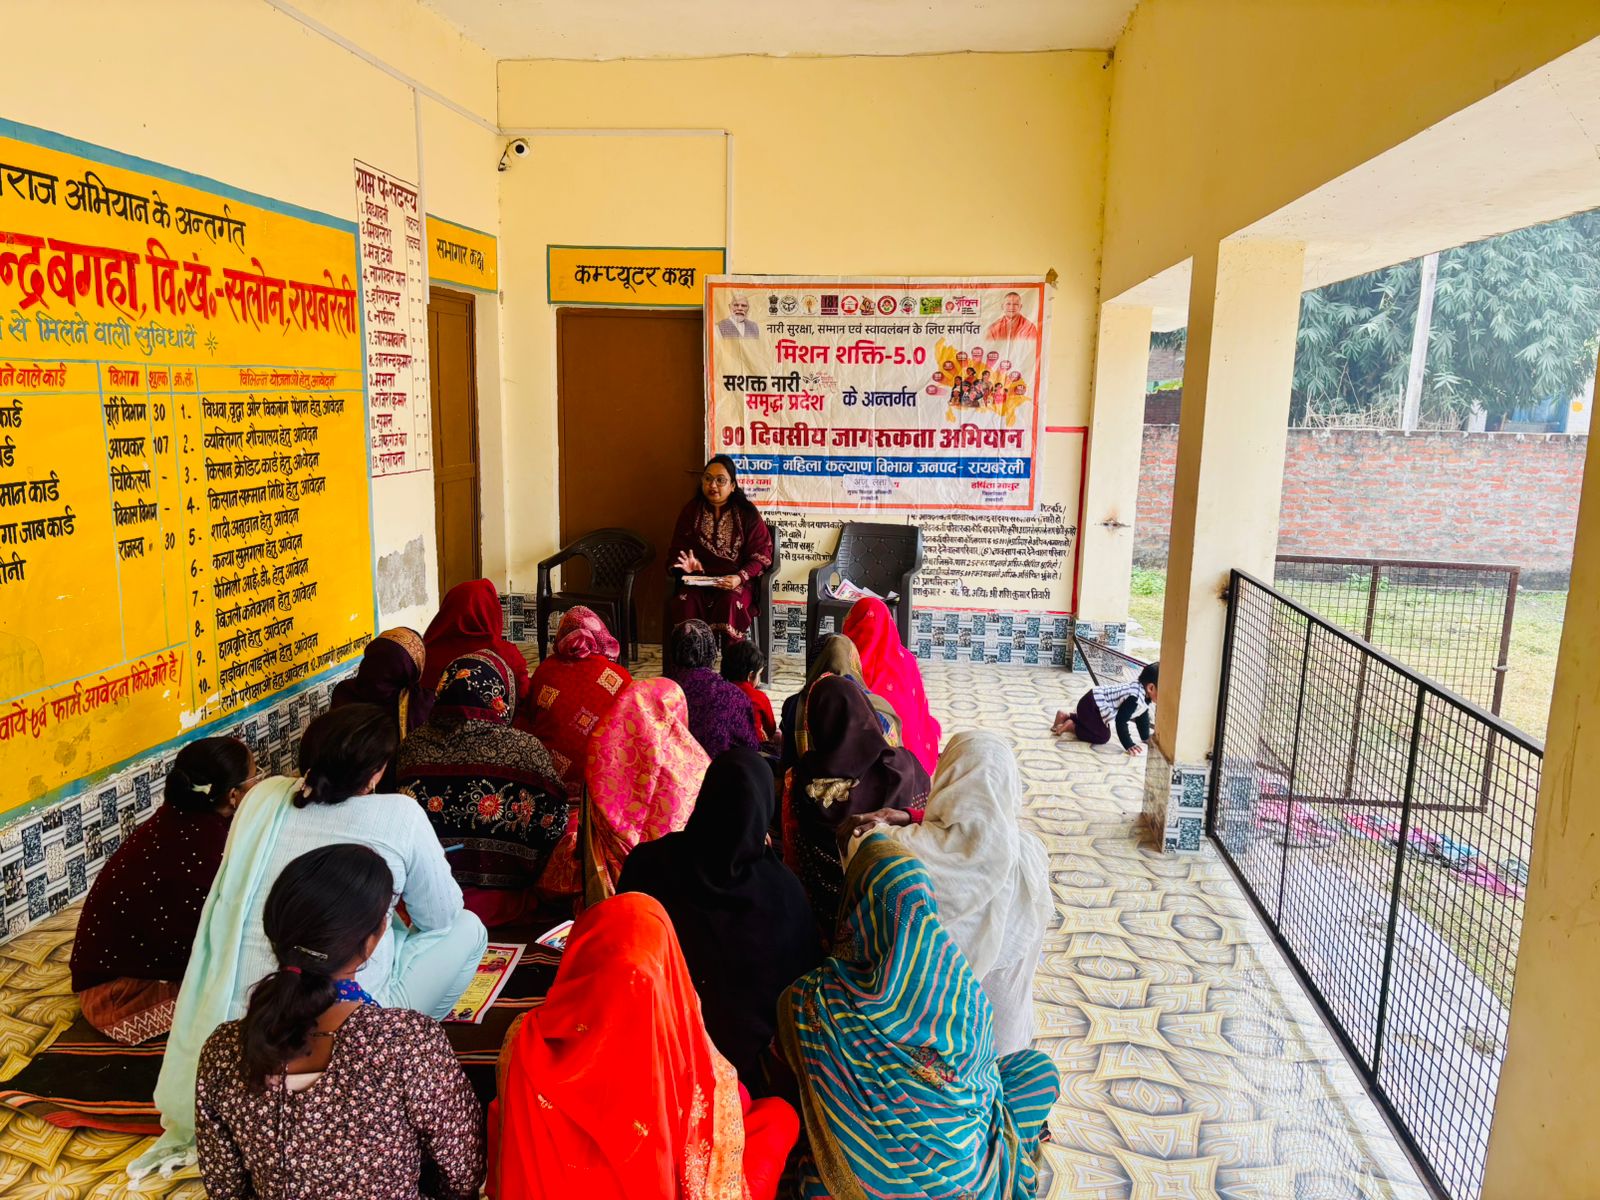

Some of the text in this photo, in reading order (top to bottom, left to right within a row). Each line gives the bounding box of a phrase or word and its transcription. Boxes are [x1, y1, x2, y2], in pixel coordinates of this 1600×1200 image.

[356, 167, 376, 198] ग्राम
[0, 163, 246, 254] राज अभियान के अन्तर्गत
[575, 264, 696, 293] कम्प्यूटर कक्ष
[9, 310, 31, 342] से
[36, 311, 90, 346] मिलने
[94, 317, 130, 349] वाली
[767, 321, 981, 336] नारी सुरक्षा, सम्मान एवं स्वावलंबन के लिए समर्पित
[776, 339, 830, 364] मिशन
[17, 363, 43, 388] वाले
[43, 361, 67, 388] कार्ड
[108, 365, 140, 387] विभाग
[149, 370, 168, 388] शुल्क
[239, 369, 269, 386] विभिन्न
[300, 371, 311, 390] हेतु
[311, 371, 336, 390] आवेदन
[723, 374, 767, 392] सशक्त
[771, 371, 801, 392] नारी
[120, 397, 146, 421] विभाग
[247, 394, 261, 419] और
[310, 395, 322, 418] हेतु
[322, 395, 345, 416] आवेदन
[745, 390, 825, 416] समृद्ध प्रदेश
[842, 386, 917, 407] के अन्तर्गत
[154, 404, 165, 421] 30
[109, 437, 146, 460] आयकर
[153, 436, 169, 454] 107
[204, 422, 318, 451] व्यक्तिगत शौचालय हेतु आवेदन
[722, 426, 744, 446] 90
[750, 421, 827, 447] दिवसीय
[940, 423, 1024, 449] अभियान
[205, 457, 232, 481] किसान
[261, 450, 278, 475] कार्ड
[279, 452, 293, 476] हेतु
[293, 448, 320, 472] आवेदन
[733, 456, 779, 472] योजक-
[783, 456, 822, 473] महिला
[826, 459, 872, 473] कल्याण
[876, 457, 913, 474] विभाग
[968, 458, 1025, 475] रायबरेली
[29, 470, 60, 503] कार्ड
[207, 488, 238, 513] किसान
[285, 478, 299, 501] हेतु
[300, 473, 326, 496] आवेदन
[47, 505, 76, 537] कार्ड
[211, 516, 230, 542] शादी
[260, 510, 273, 535] हेतु
[274, 505, 299, 528] आवेदन
[165, 532, 175, 550] 30
[212, 550, 235, 570] कन्या
[265, 538, 278, 559] हेतु
[278, 531, 303, 554] आवेदन
[272, 564, 285, 585] हेतु
[285, 557, 309, 580] आवेदन
[215, 602, 241, 630] बिजली
[278, 590, 291, 611] हेतु
[292, 581, 317, 604] आवेदन
[248, 626, 262, 648] हेतु
[264, 616, 294, 640] आवेदन
[279, 643, 293, 663] हेतु
[293, 632, 318, 655] आवेदन
[50, 681, 82, 723] फार्म
[83, 676, 131, 712] आवेदन
[131, 661, 150, 693] किये
[150, 655, 169, 686] जाते
[222, 687, 239, 712] सभी
[272, 670, 284, 690] हेतु
[284, 661, 309, 684] आवेदन
